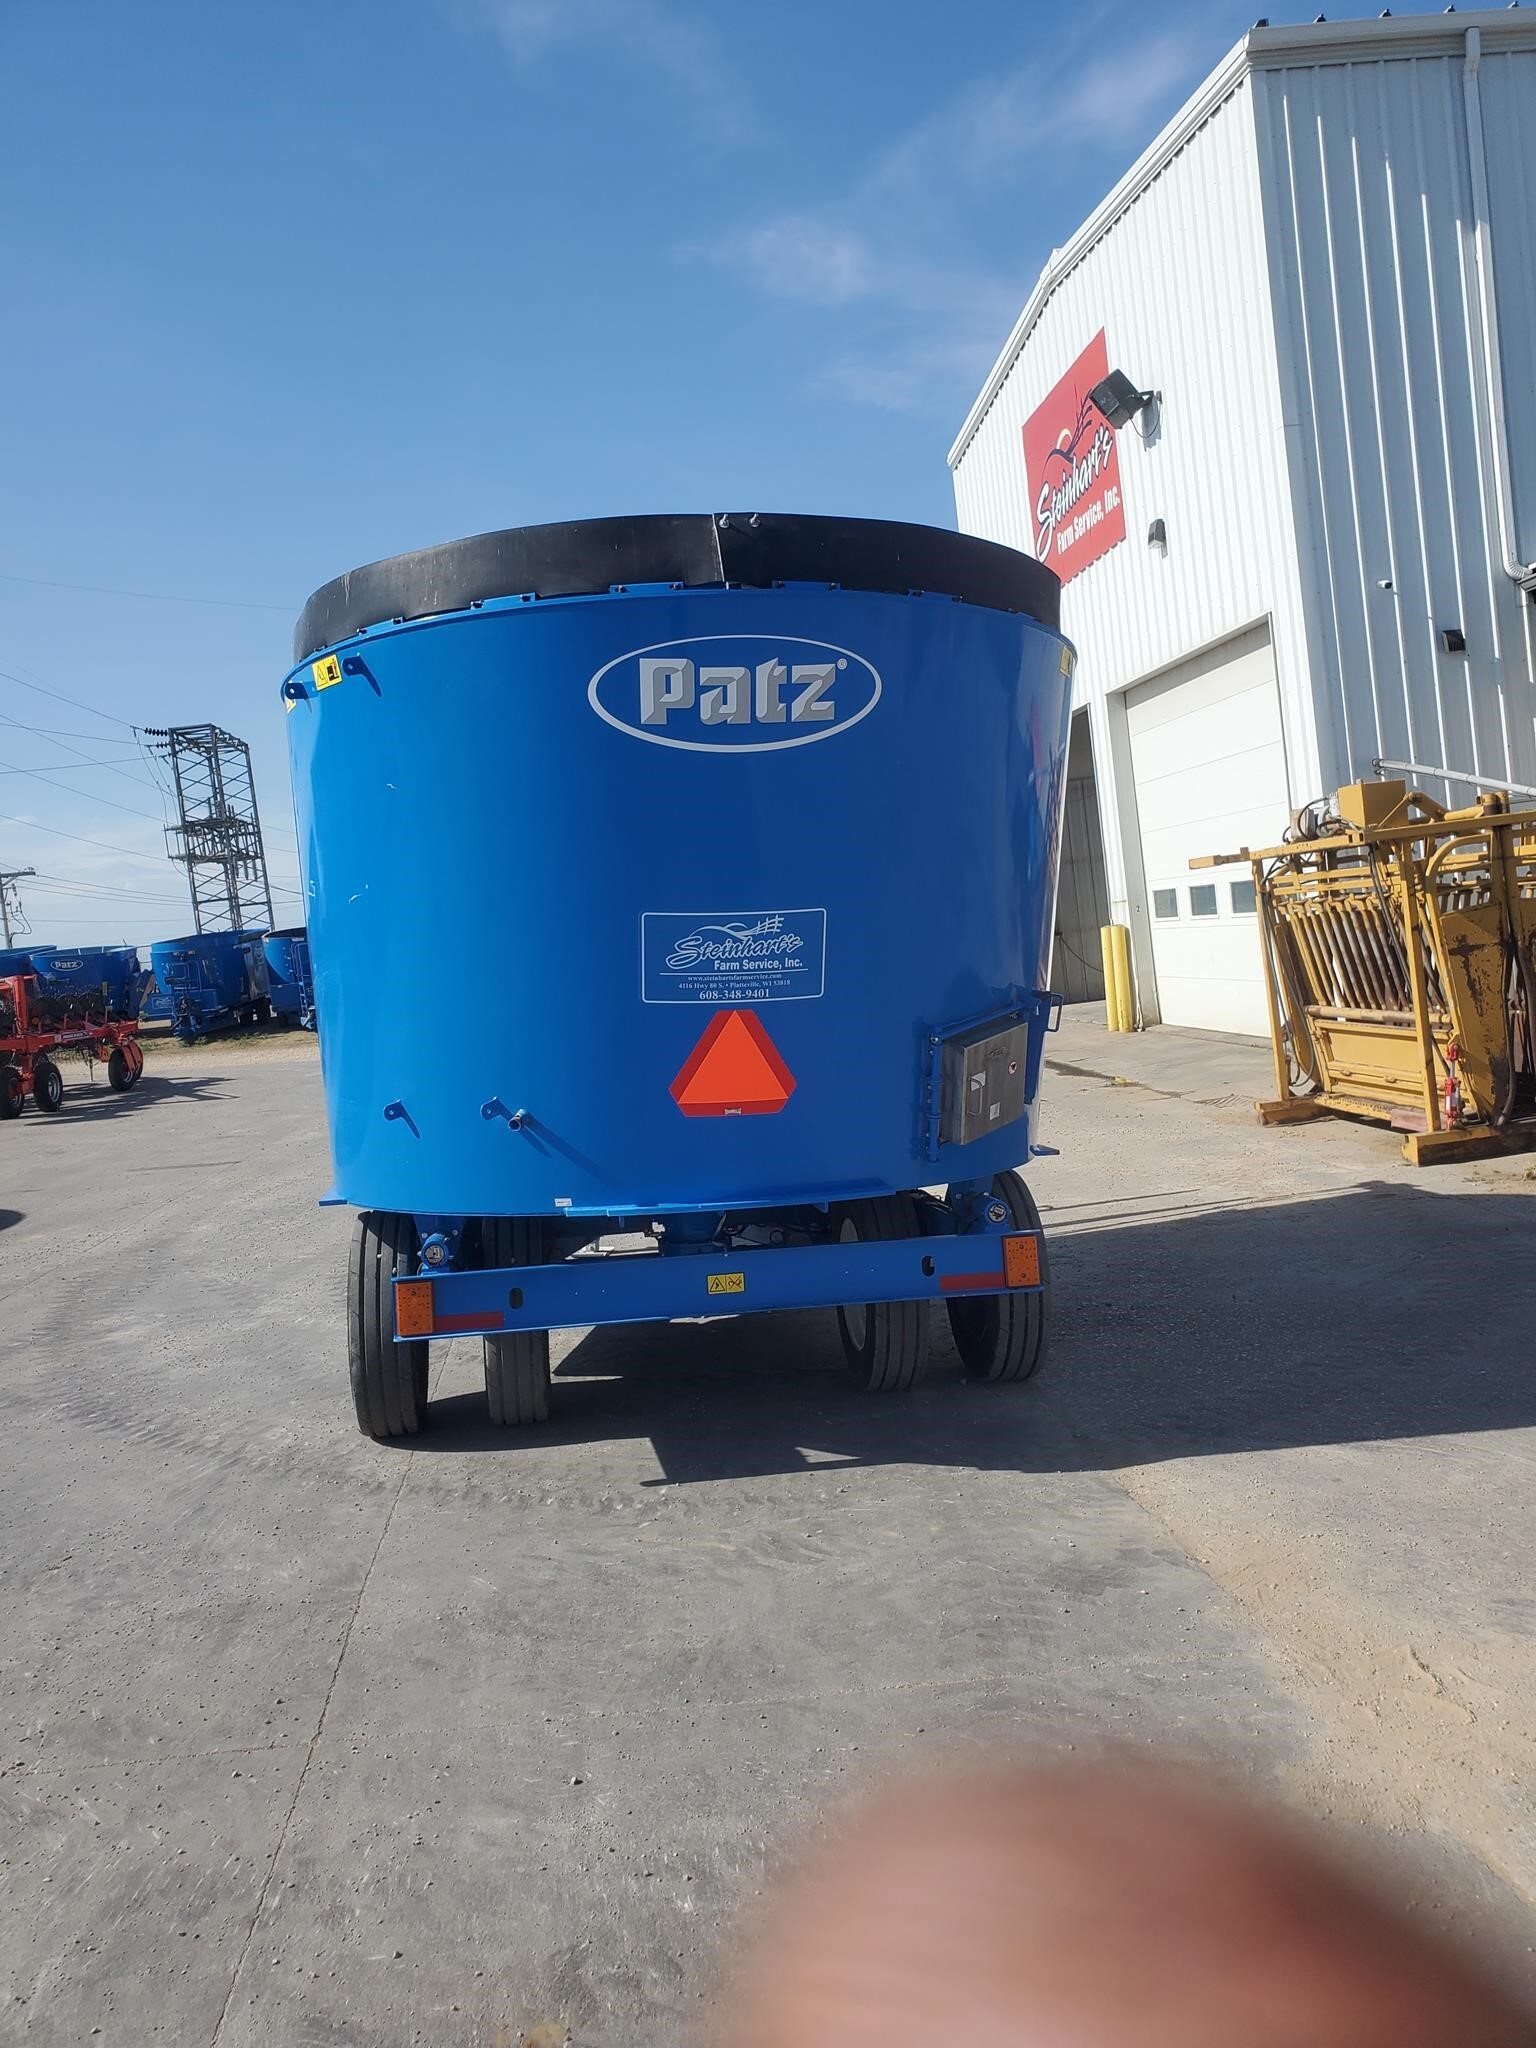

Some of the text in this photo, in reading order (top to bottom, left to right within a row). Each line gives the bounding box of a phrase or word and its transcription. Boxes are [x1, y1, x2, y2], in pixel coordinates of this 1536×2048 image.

[1036, 423, 1114, 563] Steinhart's
[1057, 485, 1121, 555] Farm Service, Inc.
[666, 933, 804, 970] Steinhart's
[714, 956, 803, 971] Farm Service, Inc.
[699, 988, 769, 1000] 608-348-9401
